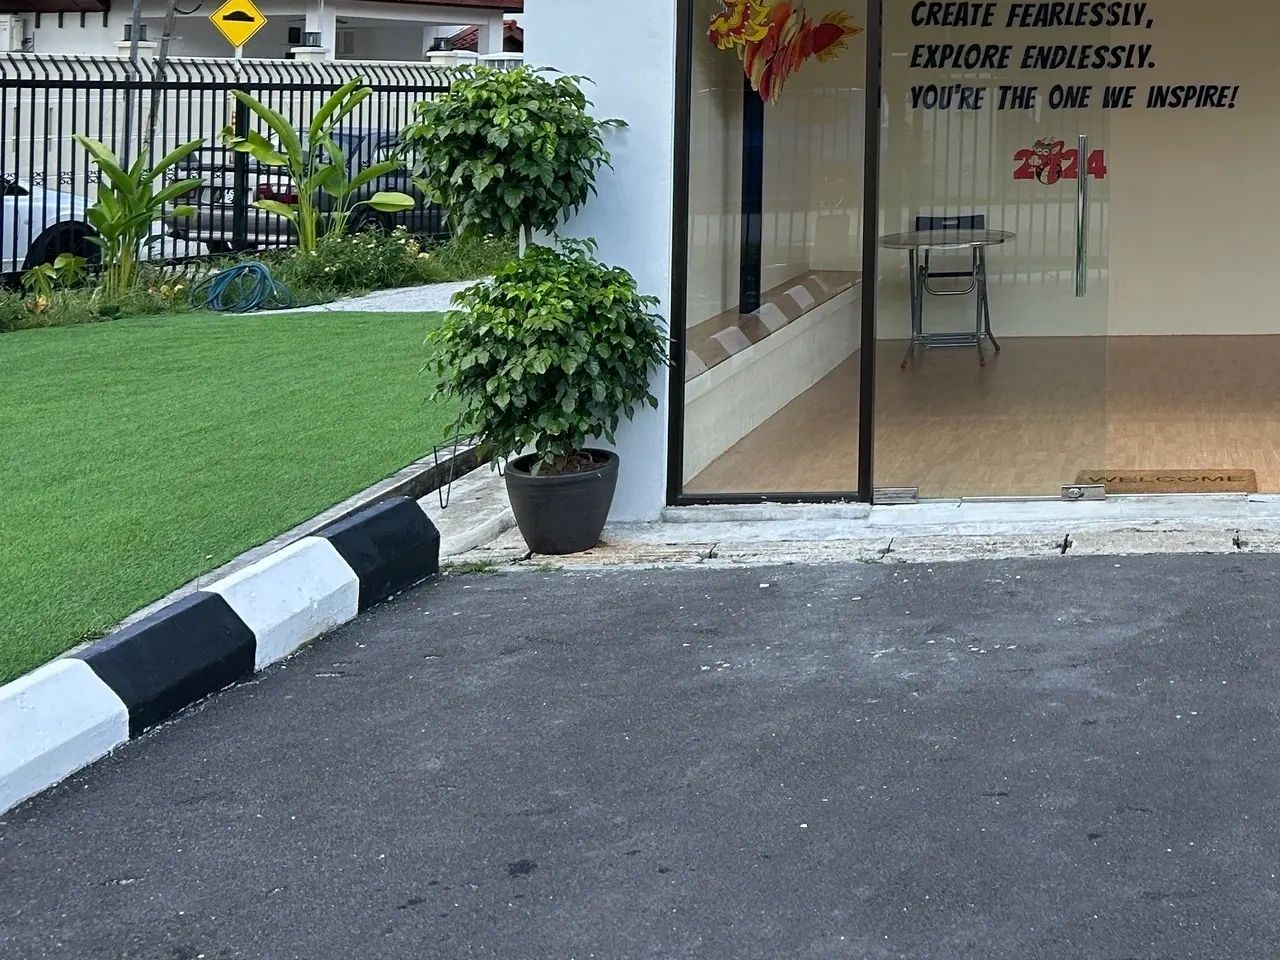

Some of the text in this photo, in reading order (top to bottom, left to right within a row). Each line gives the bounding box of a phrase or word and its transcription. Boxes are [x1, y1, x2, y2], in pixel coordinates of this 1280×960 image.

[911, 0, 1154, 29] CREATE FEARLESSLY,
[910, 43, 1155, 70] EXPLORE ENDLESSLY.
[910, 84, 1240, 110] YOU'RE THE ONE WE INSPIRE!
[1088, 475, 1246, 483] WELCOME
